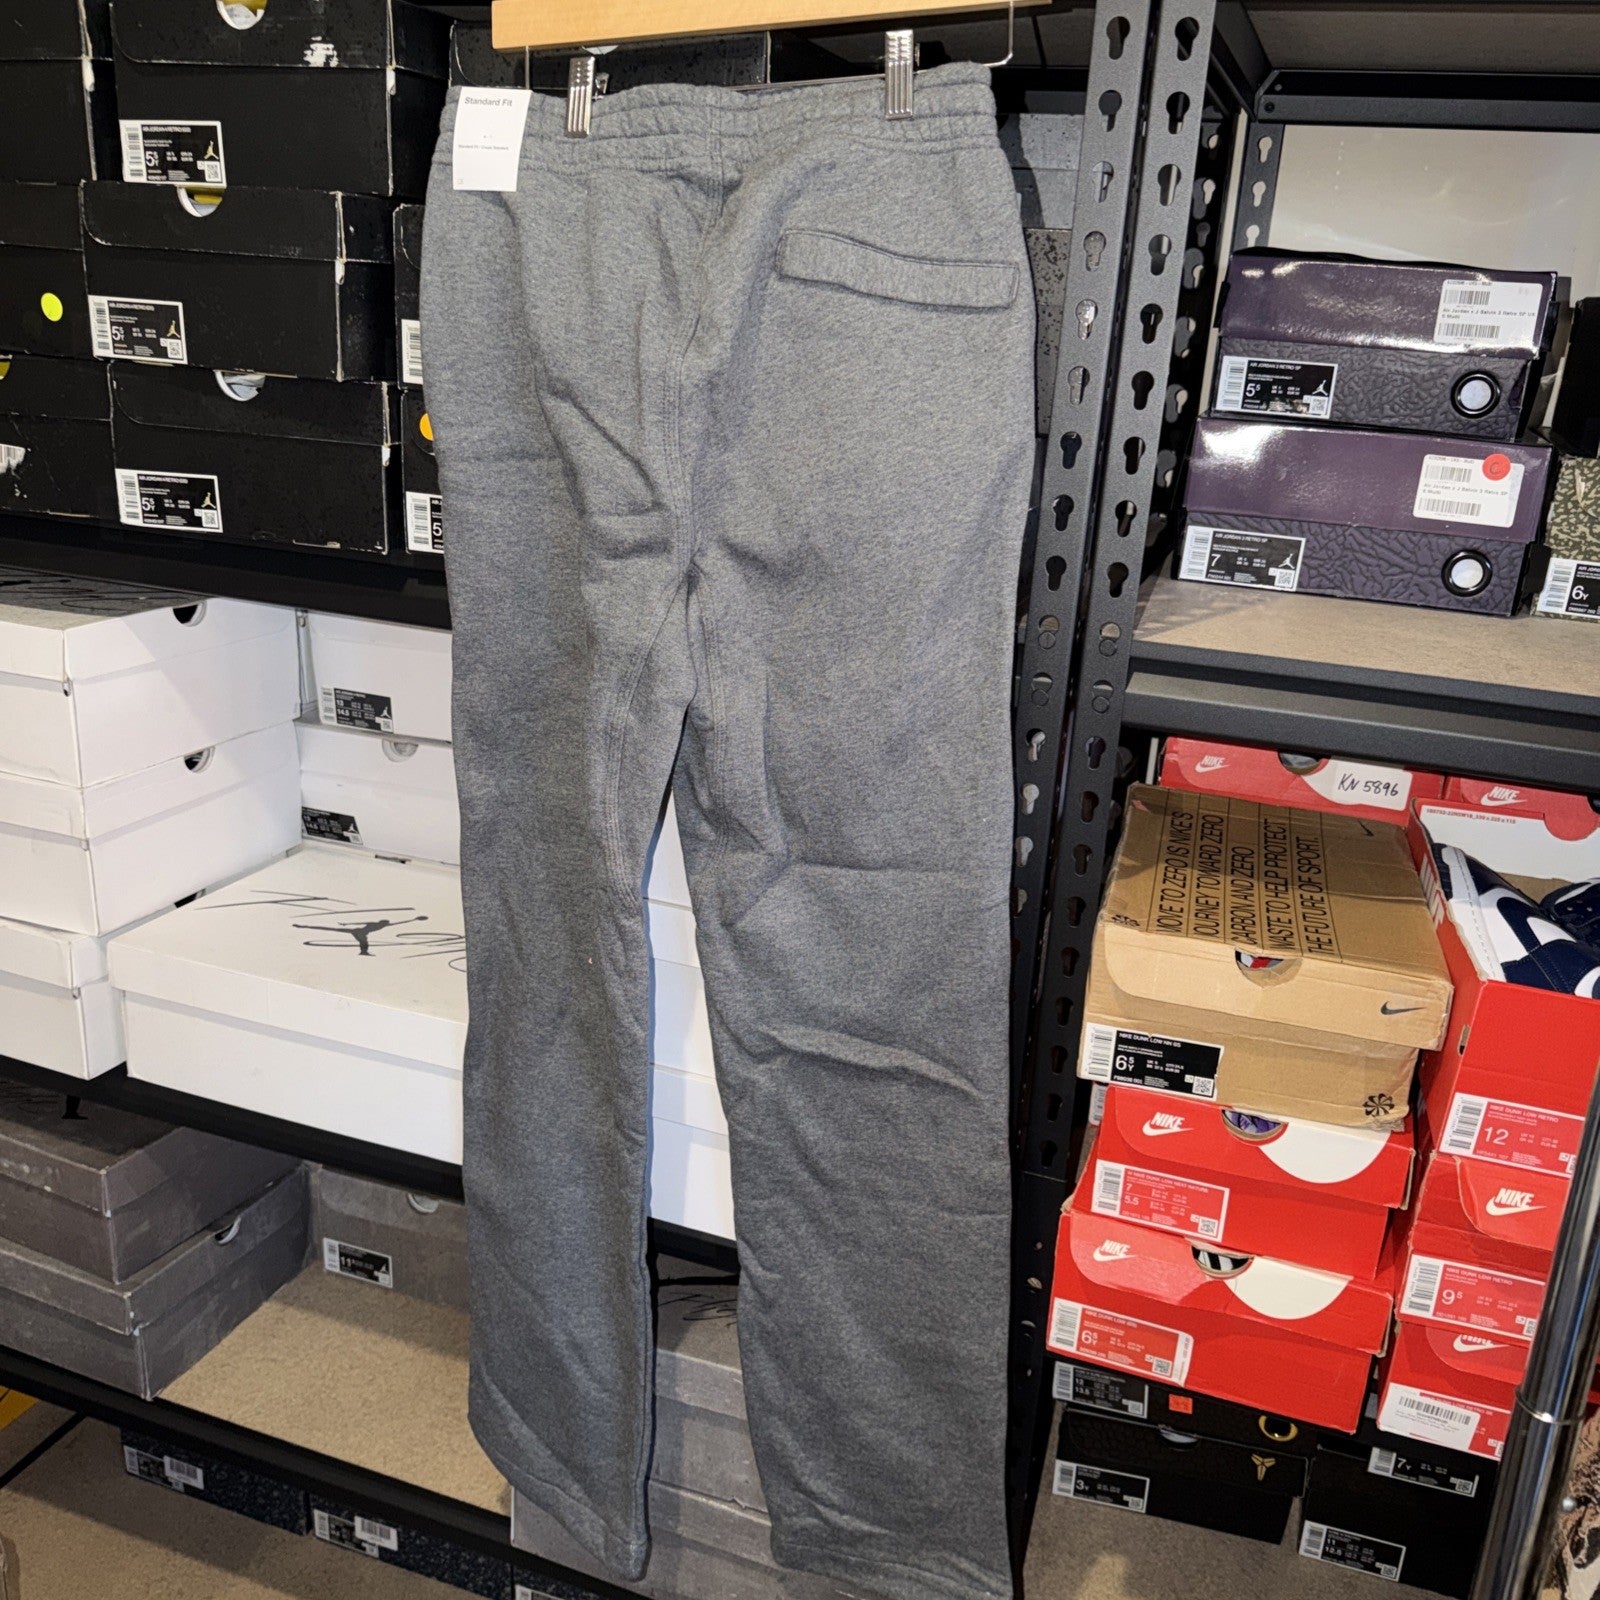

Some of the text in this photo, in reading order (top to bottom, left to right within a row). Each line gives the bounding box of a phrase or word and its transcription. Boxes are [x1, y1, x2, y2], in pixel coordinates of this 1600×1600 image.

[464, 97, 500, 106] Standard
[1211, 554, 1221, 567] 7
[1201, 755, 1225, 766] NIKE
[1363, 780, 1399, 797] 5896
[1490, 786, 1520, 800] NIKE
[1200, 815, 1224, 844] ZERO
[1166, 845, 1189, 858] IS
[1163, 858, 1188, 889] ZERO
[1196, 844, 1221, 890] TOWARD
[1264, 819, 1296, 949] WASTE TO HELP PROTECT
[1160, 888, 1185, 903] TO
[1230, 847, 1258, 945] CARBON AND ZERO
[1296, 837, 1335, 955] THE FUTURE OF SPORT.
[1151, 1112, 1185, 1129] NIKE
[1538, 1113, 1559, 1123] RETRO
[1484, 1126, 1509, 1145] 12
[1126, 1183, 1132, 1191] 7
[1125, 1195, 1139, 1206] 5.5
[1495, 1187, 1534, 1207] NIKE
[1100, 1240, 1130, 1255] NIKE
[1460, 1270, 1477, 1278] DUNK
[1491, 1277, 1513, 1286] RETRO
[1098, 1313, 1113, 1321] DUNK
